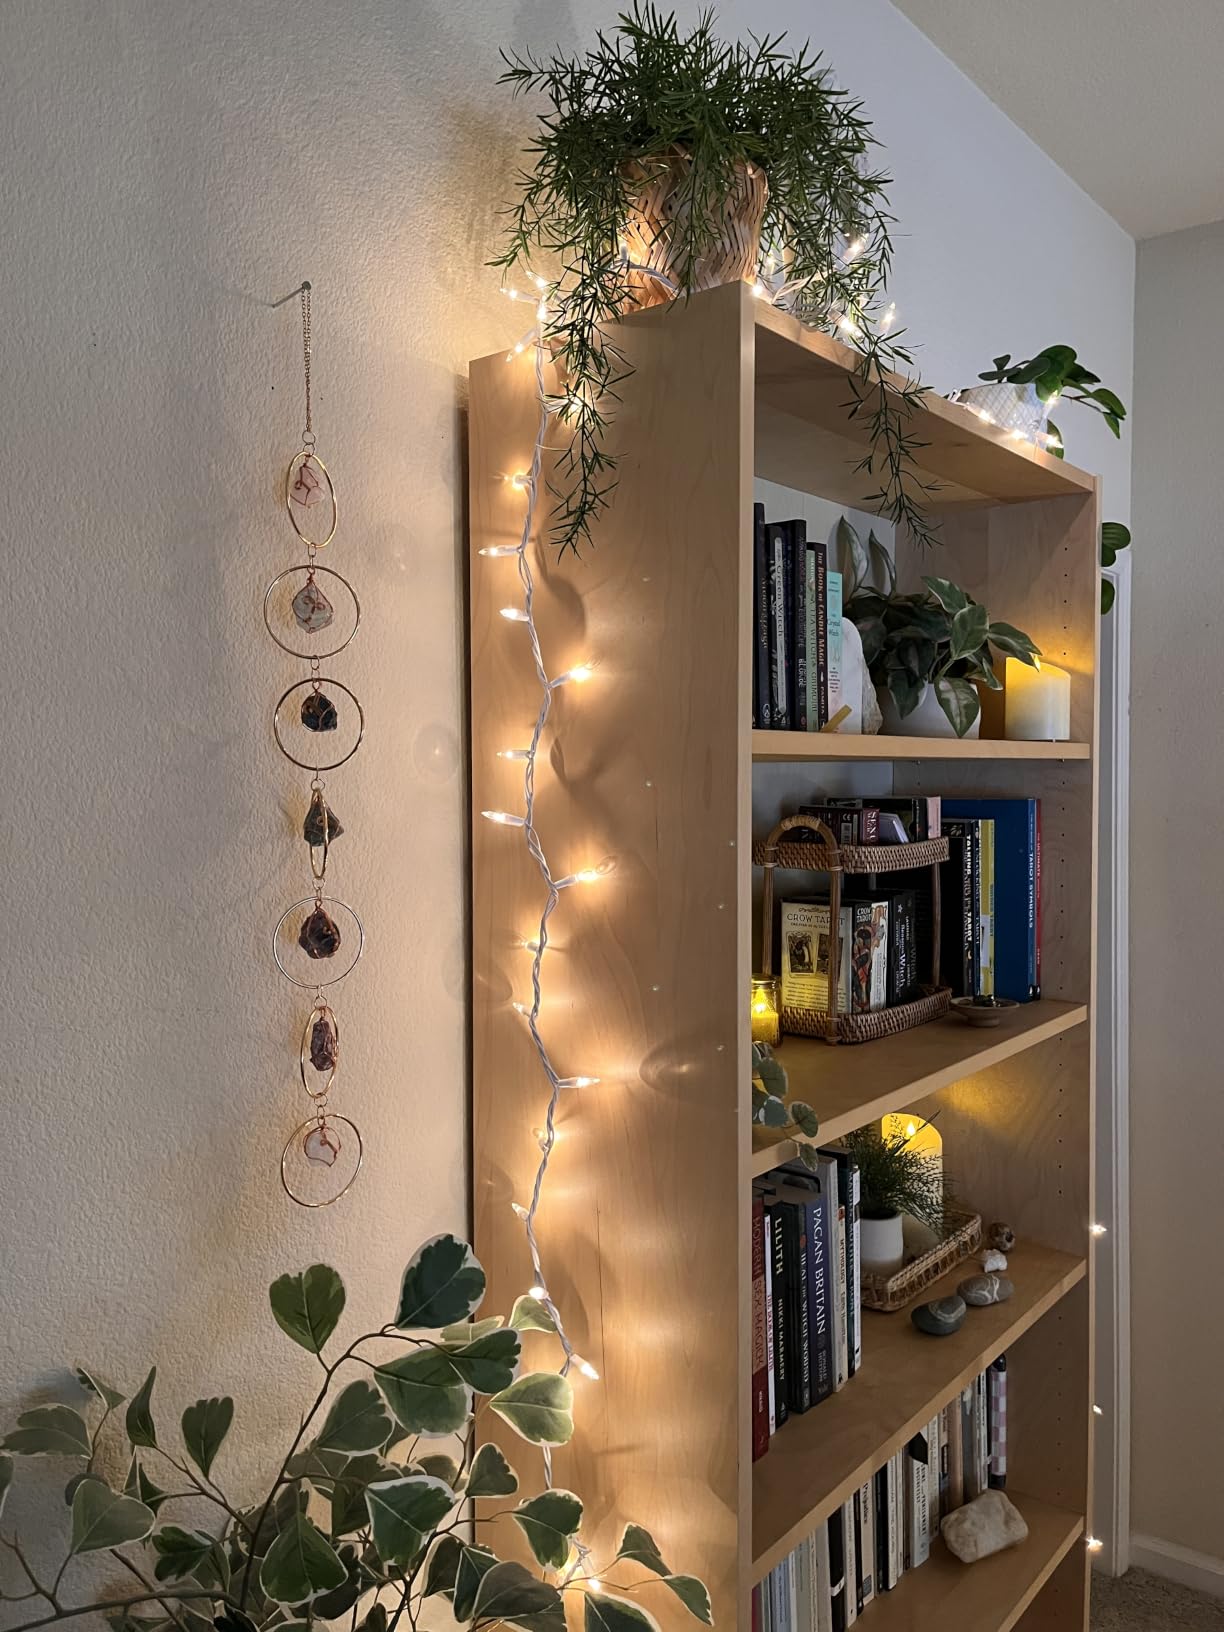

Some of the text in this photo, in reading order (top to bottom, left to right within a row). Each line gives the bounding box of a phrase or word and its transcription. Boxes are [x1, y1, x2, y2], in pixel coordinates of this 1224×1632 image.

[817, 567, 825, 591] BOOK
[777, 603, 785, 637] Witch
[817, 604, 825, 635] CANDLE
[787, 913, 845, 925] CROW TART
[899, 954, 907, 987] Witch
[774, 1216, 784, 1275] LILITH
[813, 1207, 826, 1335] PAGAN BRITAIN
[754, 1279, 763, 1306] SEX
[754, 1311, 763, 1367] MAGICK
[861, 1482, 869, 1524] Prejudice
